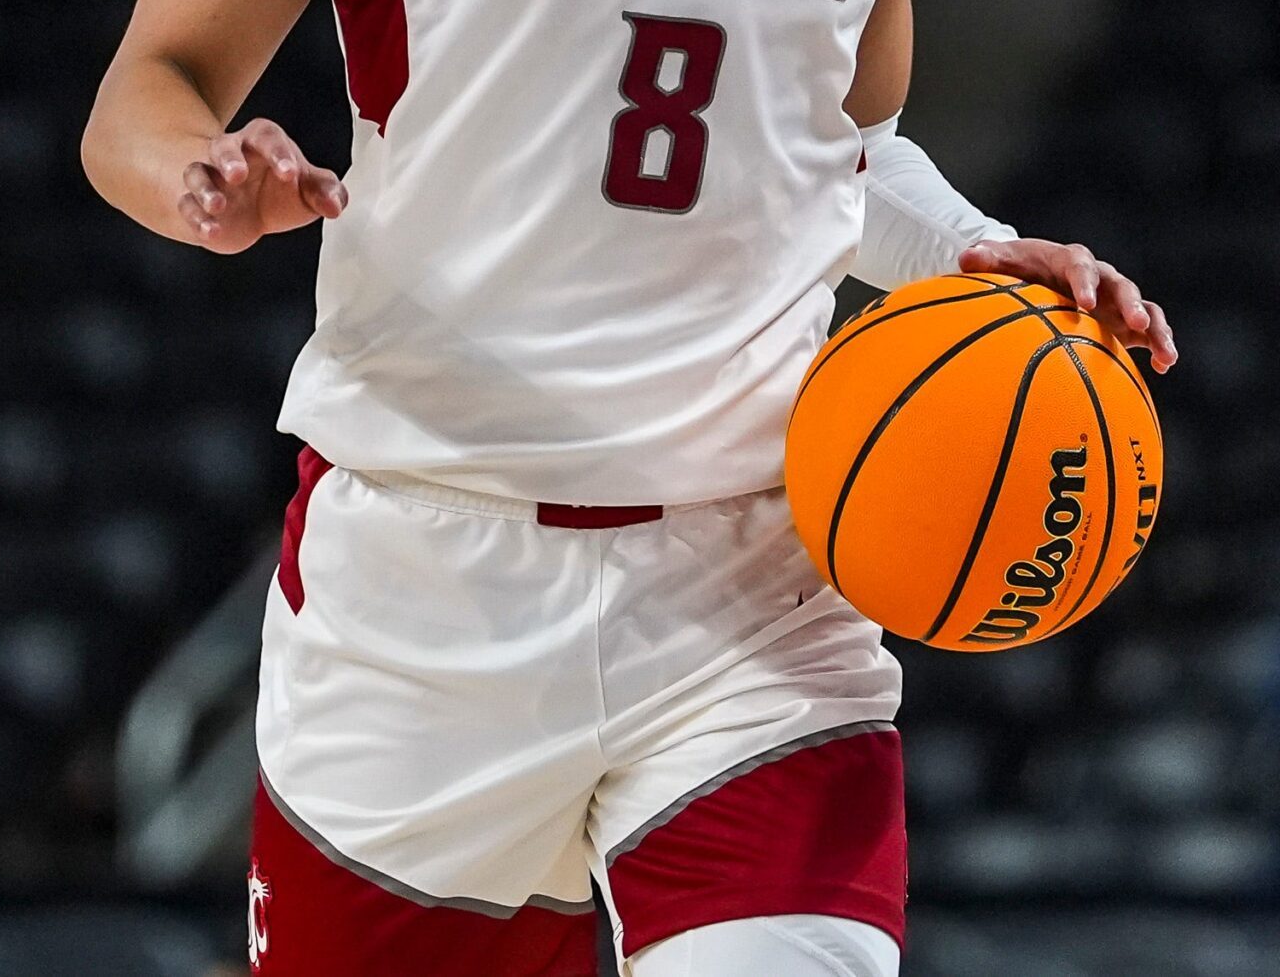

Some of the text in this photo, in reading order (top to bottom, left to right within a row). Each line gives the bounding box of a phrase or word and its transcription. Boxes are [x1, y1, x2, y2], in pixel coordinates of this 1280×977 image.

[601, 11, 727, 215] 8
[1129, 436, 1147, 481] NXT
[958, 445, 1088, 644] Wilson
[1081, 512, 1092, 541] BALL
